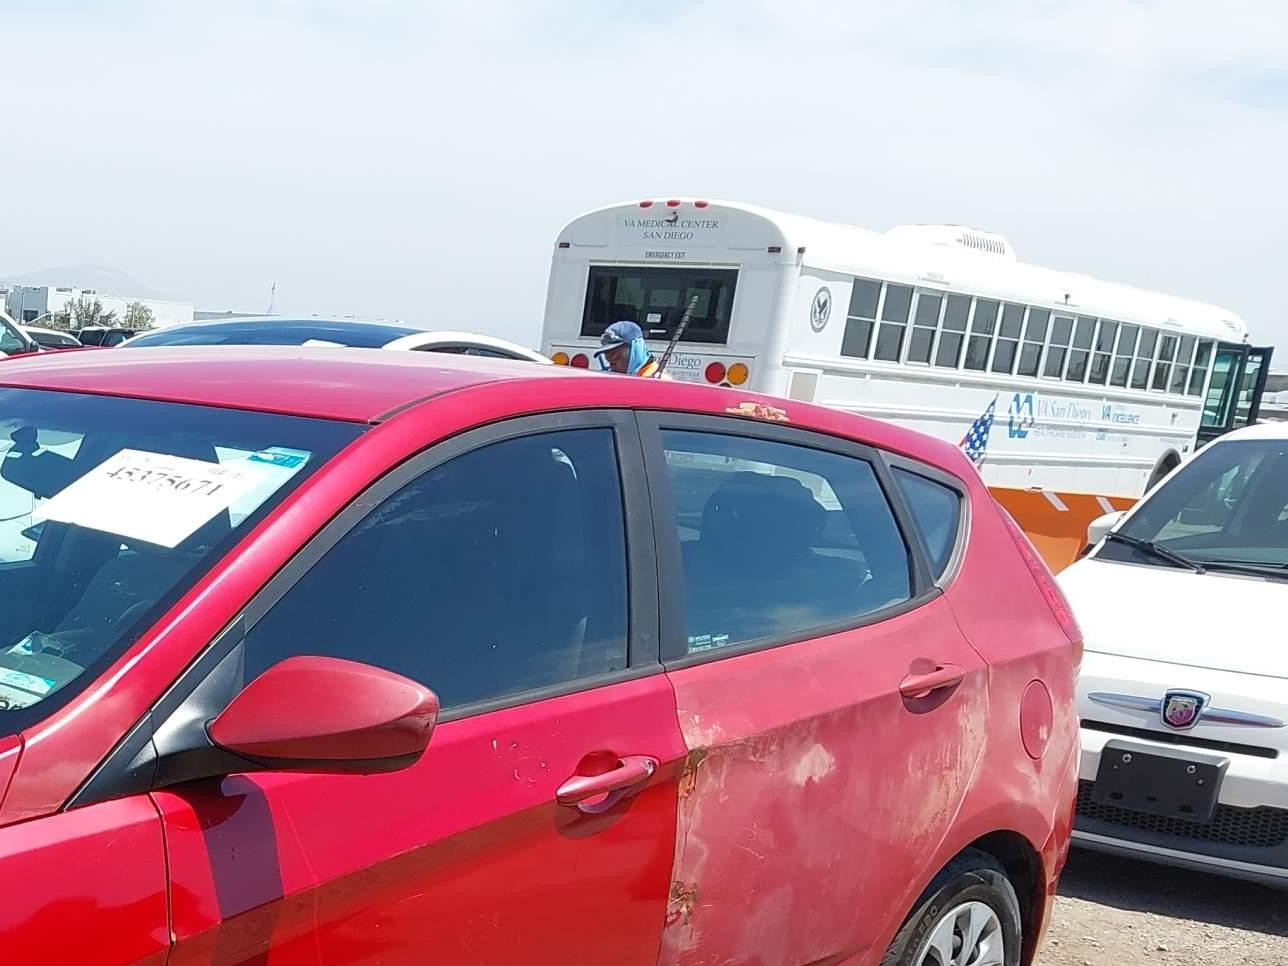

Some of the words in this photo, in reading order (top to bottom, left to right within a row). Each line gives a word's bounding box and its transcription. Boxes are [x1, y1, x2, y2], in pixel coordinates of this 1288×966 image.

[624, 219, 635, 228] VA
[636, 219, 679, 229] MEDICAL
[681, 220, 719, 229] CENTER
[643, 231, 661, 239] SAN
[663, 231, 694, 240] DIEGO
[645, 251, 674, 259] EMERGENCY
[675, 251, 686, 259] EXIT
